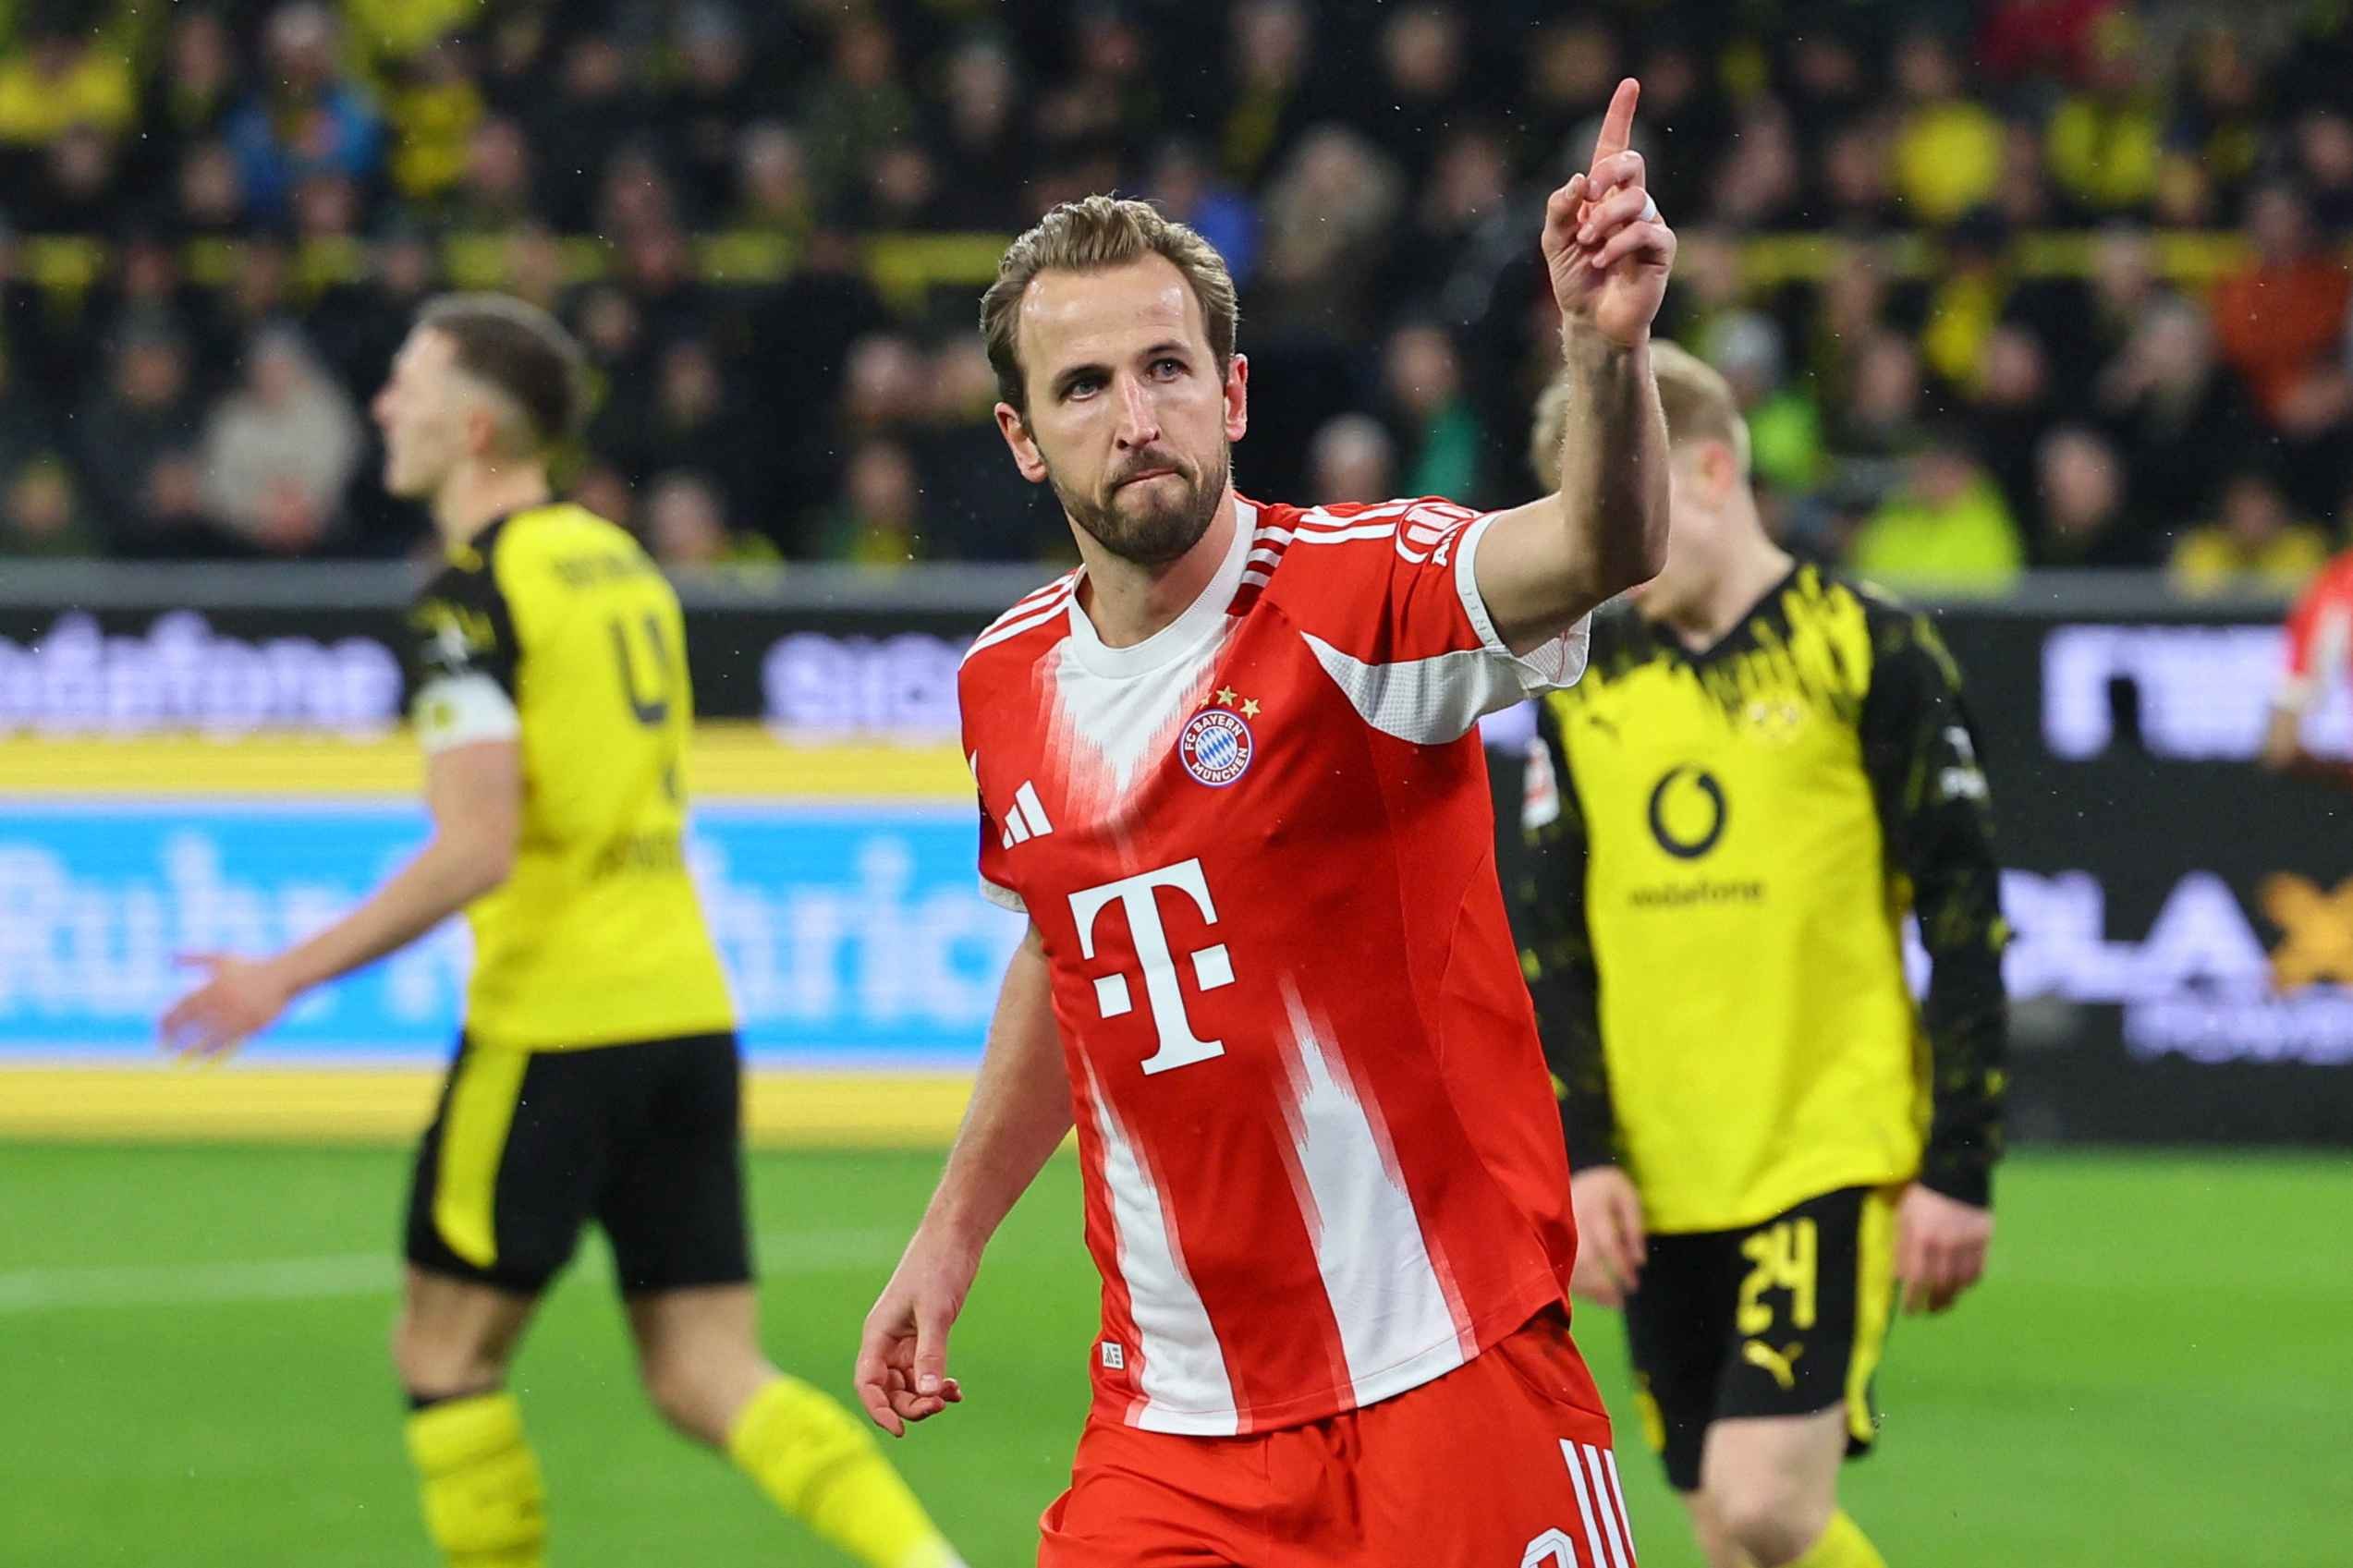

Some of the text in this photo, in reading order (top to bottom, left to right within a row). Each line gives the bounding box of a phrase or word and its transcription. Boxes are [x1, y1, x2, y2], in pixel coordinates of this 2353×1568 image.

[1185, 714, 1244, 751] FC BAYERN
[1627, 878, 1766, 910] vodafone
[1067, 857, 1236, 1076] T
[1737, 1216, 1817, 1336] 24
